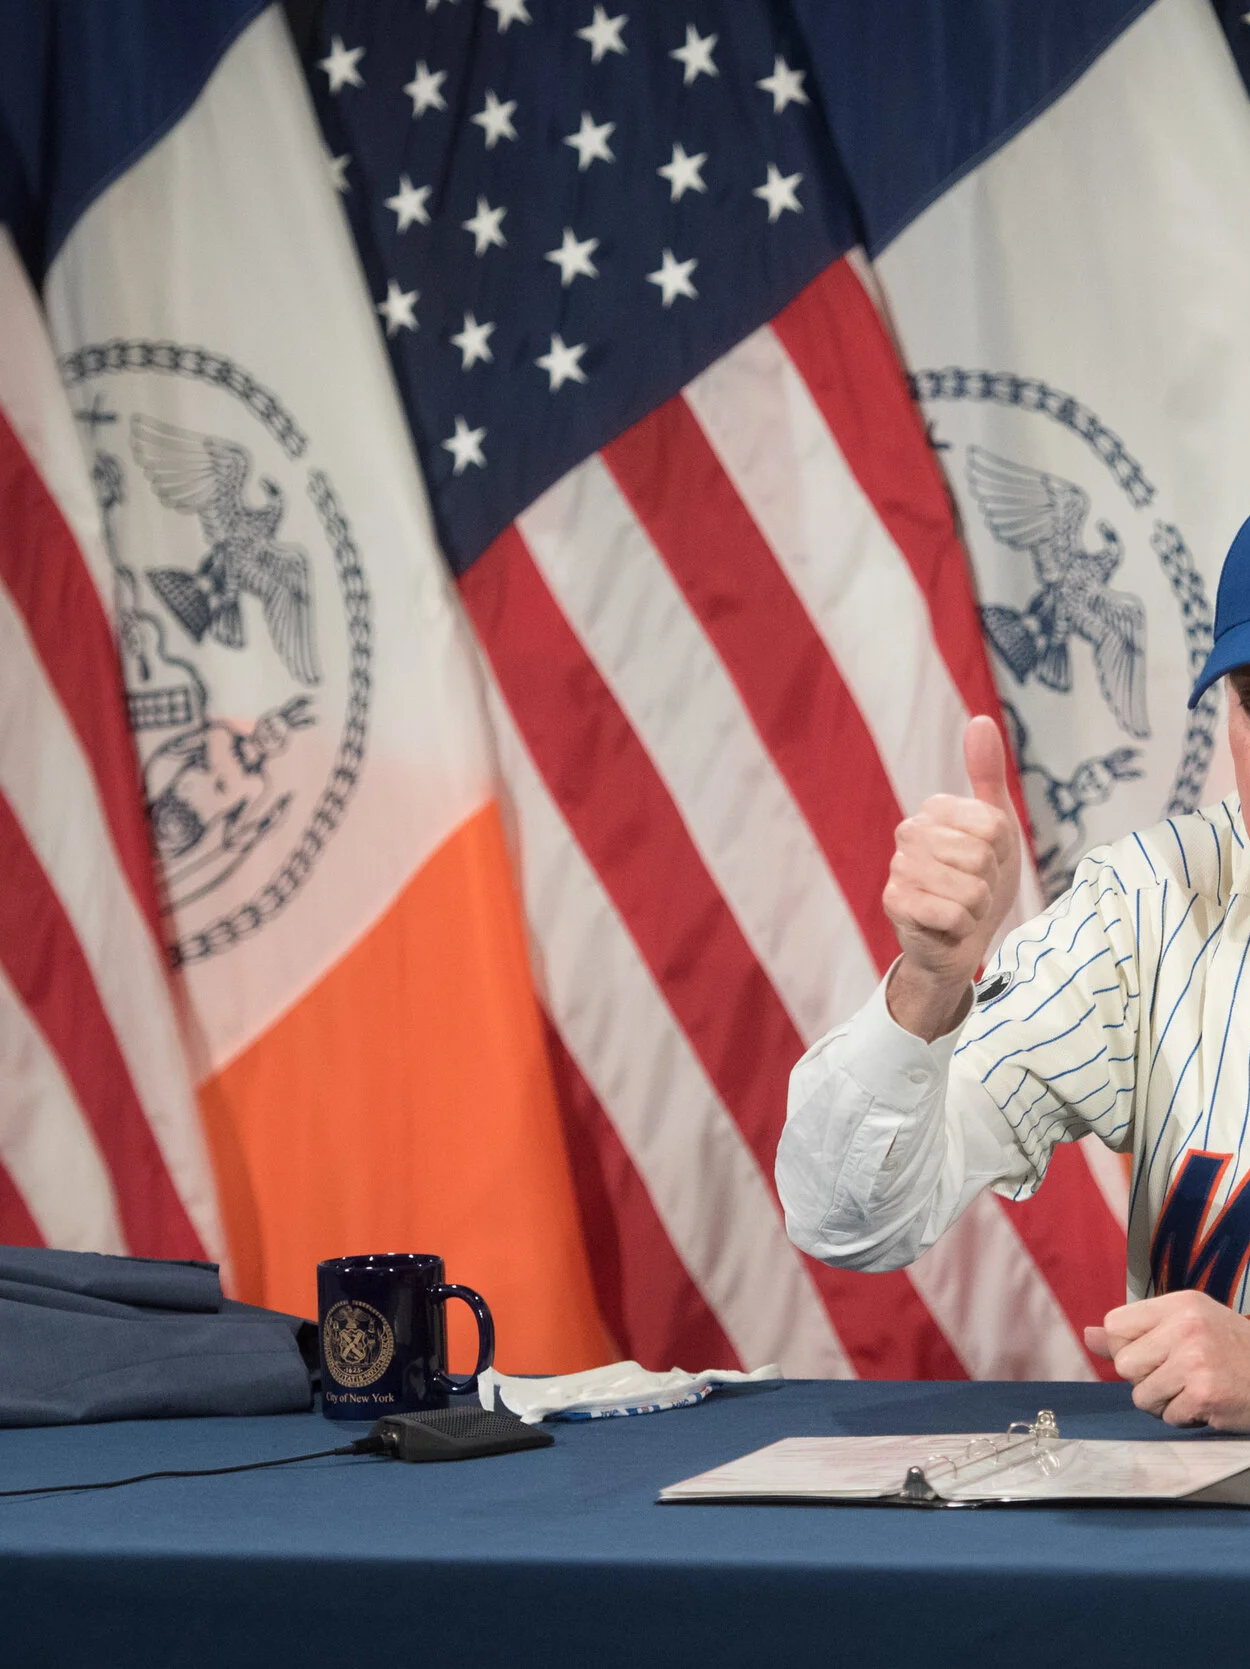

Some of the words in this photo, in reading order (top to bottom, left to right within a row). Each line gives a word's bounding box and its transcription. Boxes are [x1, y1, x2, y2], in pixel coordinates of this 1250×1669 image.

[339, 1392, 348, 1402] of
[349, 1393, 369, 1403] New
[371, 1392, 395, 1403] York
